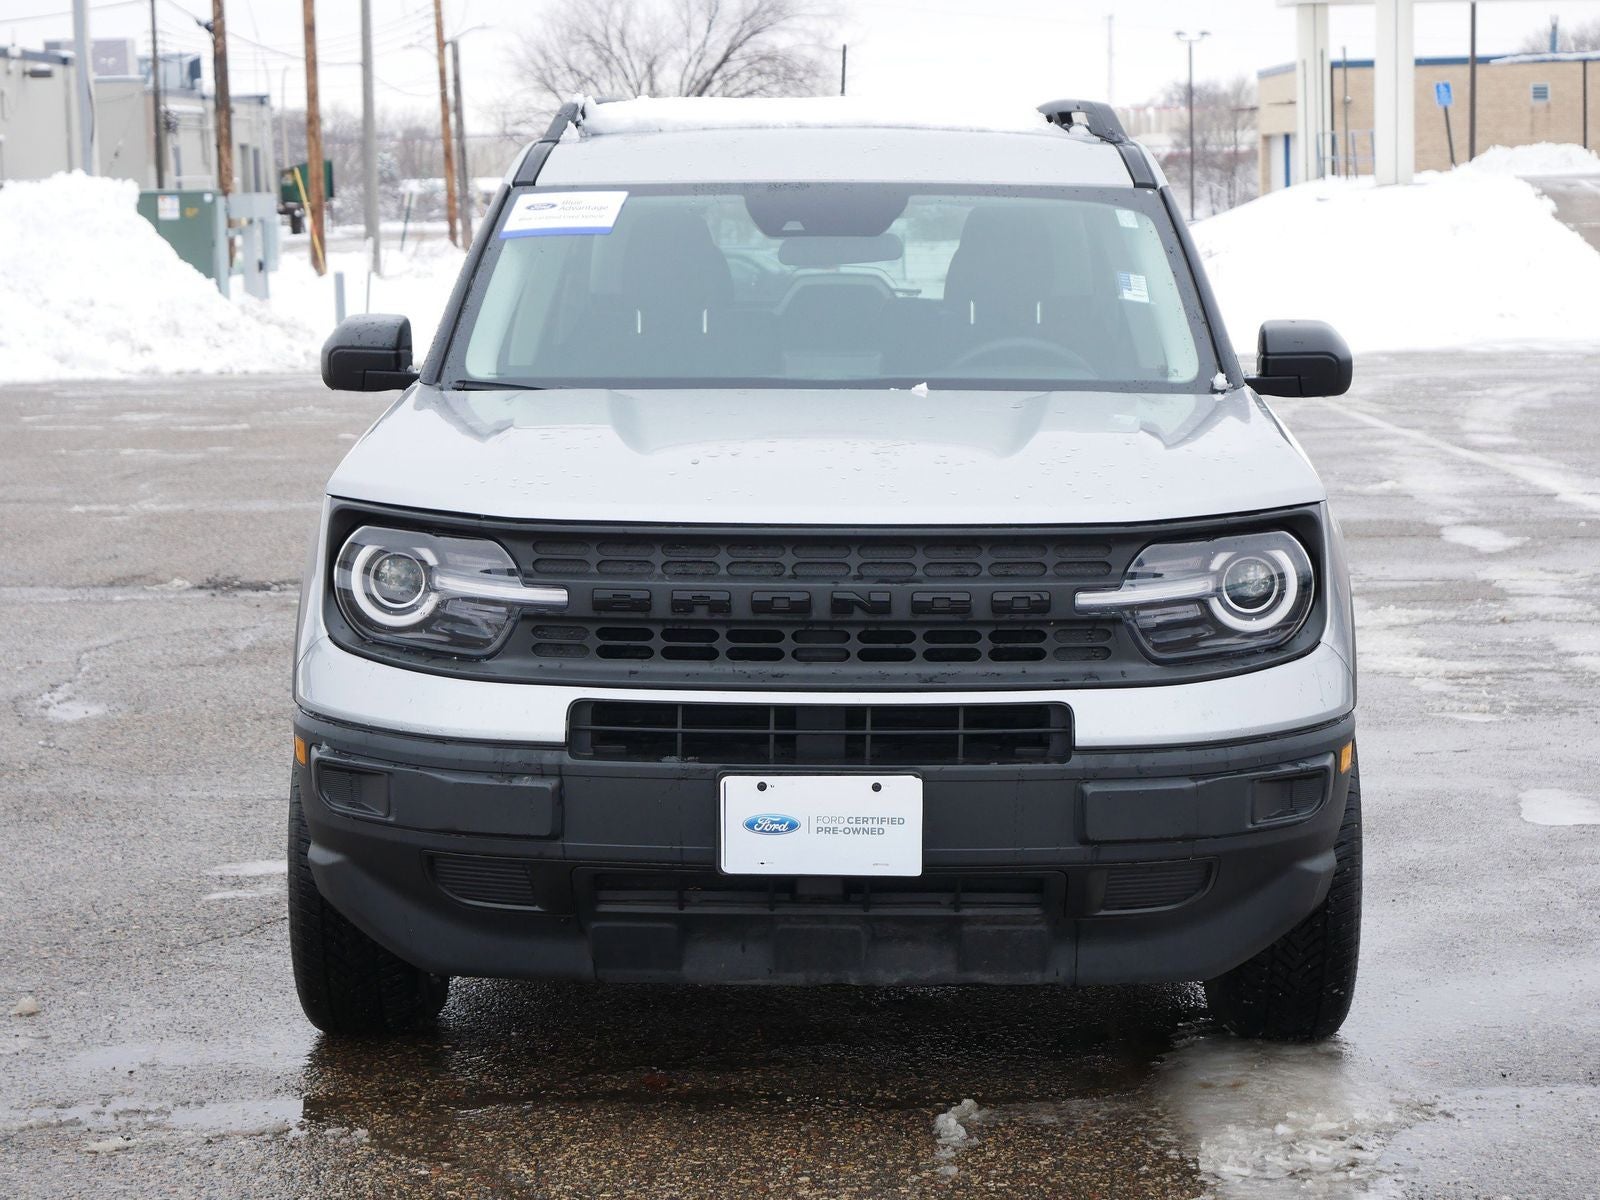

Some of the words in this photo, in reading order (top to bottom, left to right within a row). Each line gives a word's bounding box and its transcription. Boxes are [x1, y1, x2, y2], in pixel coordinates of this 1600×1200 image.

[592, 588, 1051, 615] BRONCO
[754, 816, 788, 832] Ford
[816, 815, 845, 825] FORD
[846, 816, 905, 826] CERTIFIED
[816, 826, 885, 836] PRE-OWNED
